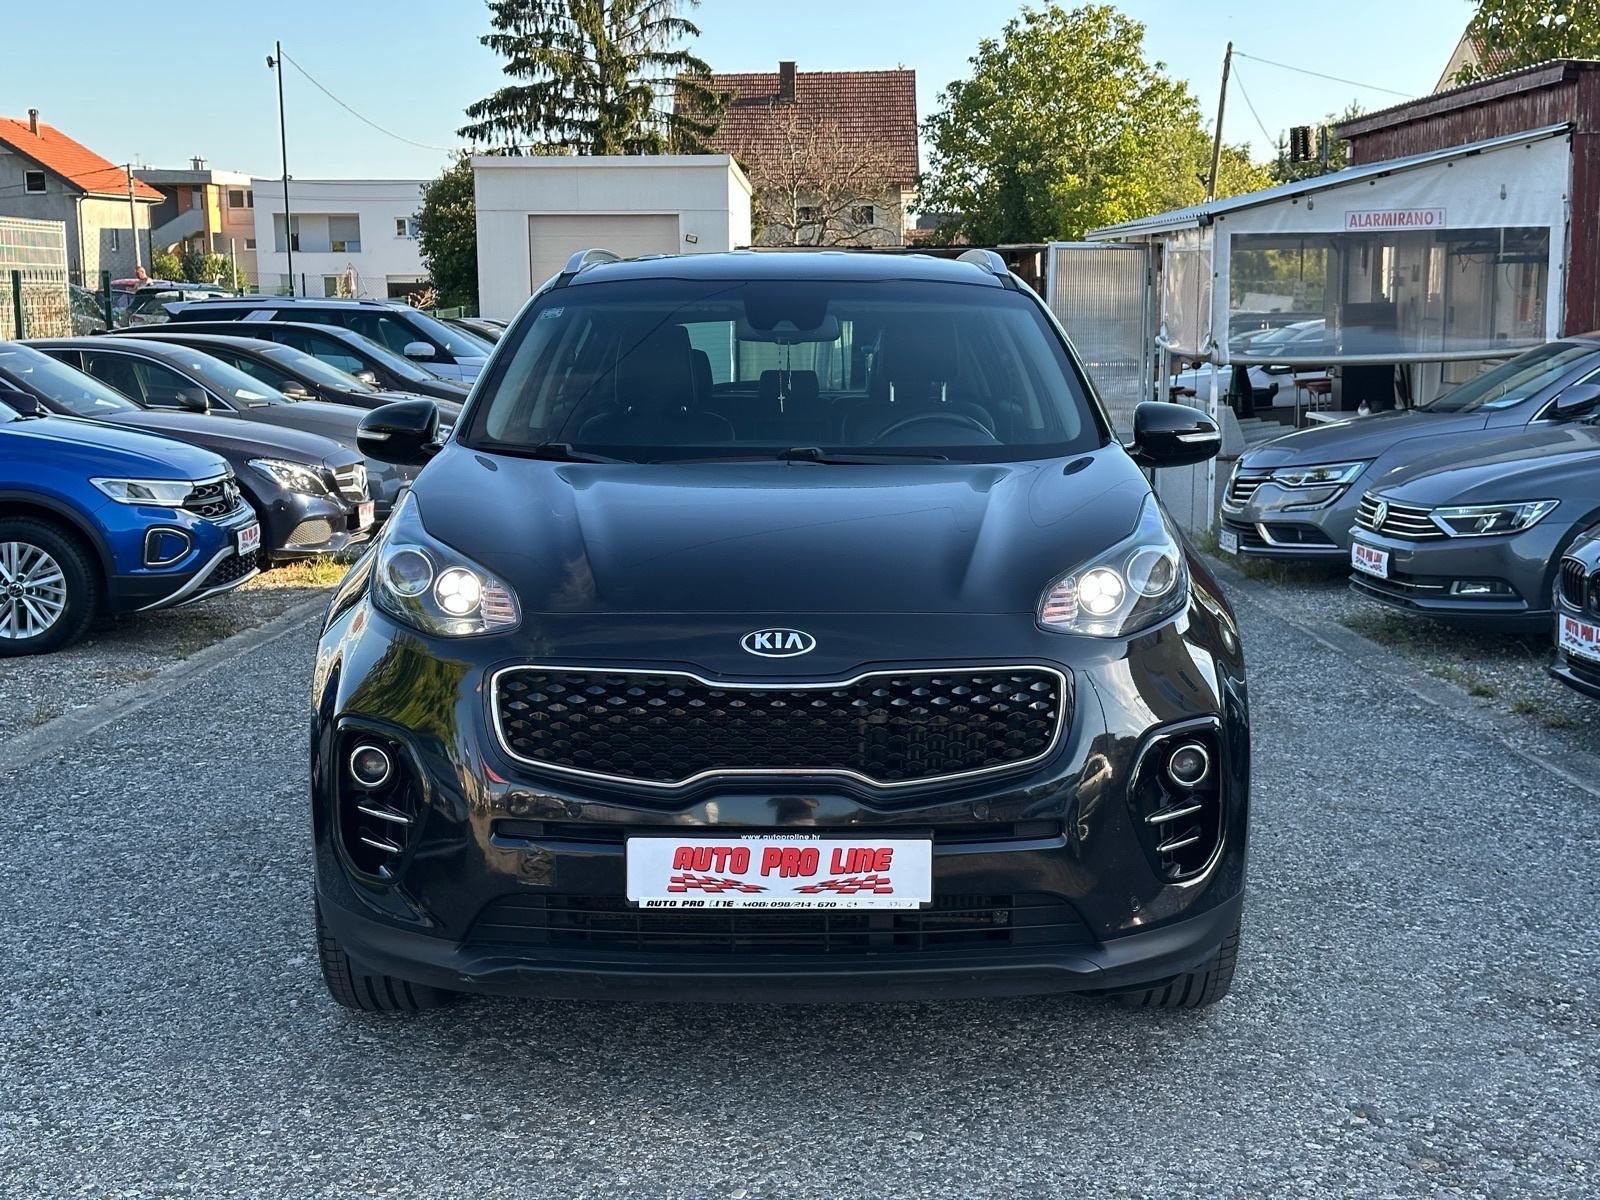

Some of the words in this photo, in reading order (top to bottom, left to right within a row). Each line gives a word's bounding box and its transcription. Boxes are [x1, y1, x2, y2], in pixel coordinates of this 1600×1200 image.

[1349, 212, 1434, 227] ALARMIRANO
[754, 632, 804, 650] KIA
[673, 847, 750, 875] AUTO
[761, 848, 819, 877] PRO
[830, 848, 893, 875] LINE
[646, 900, 677, 908] AUTO
[681, 900, 705, 908] PRO
